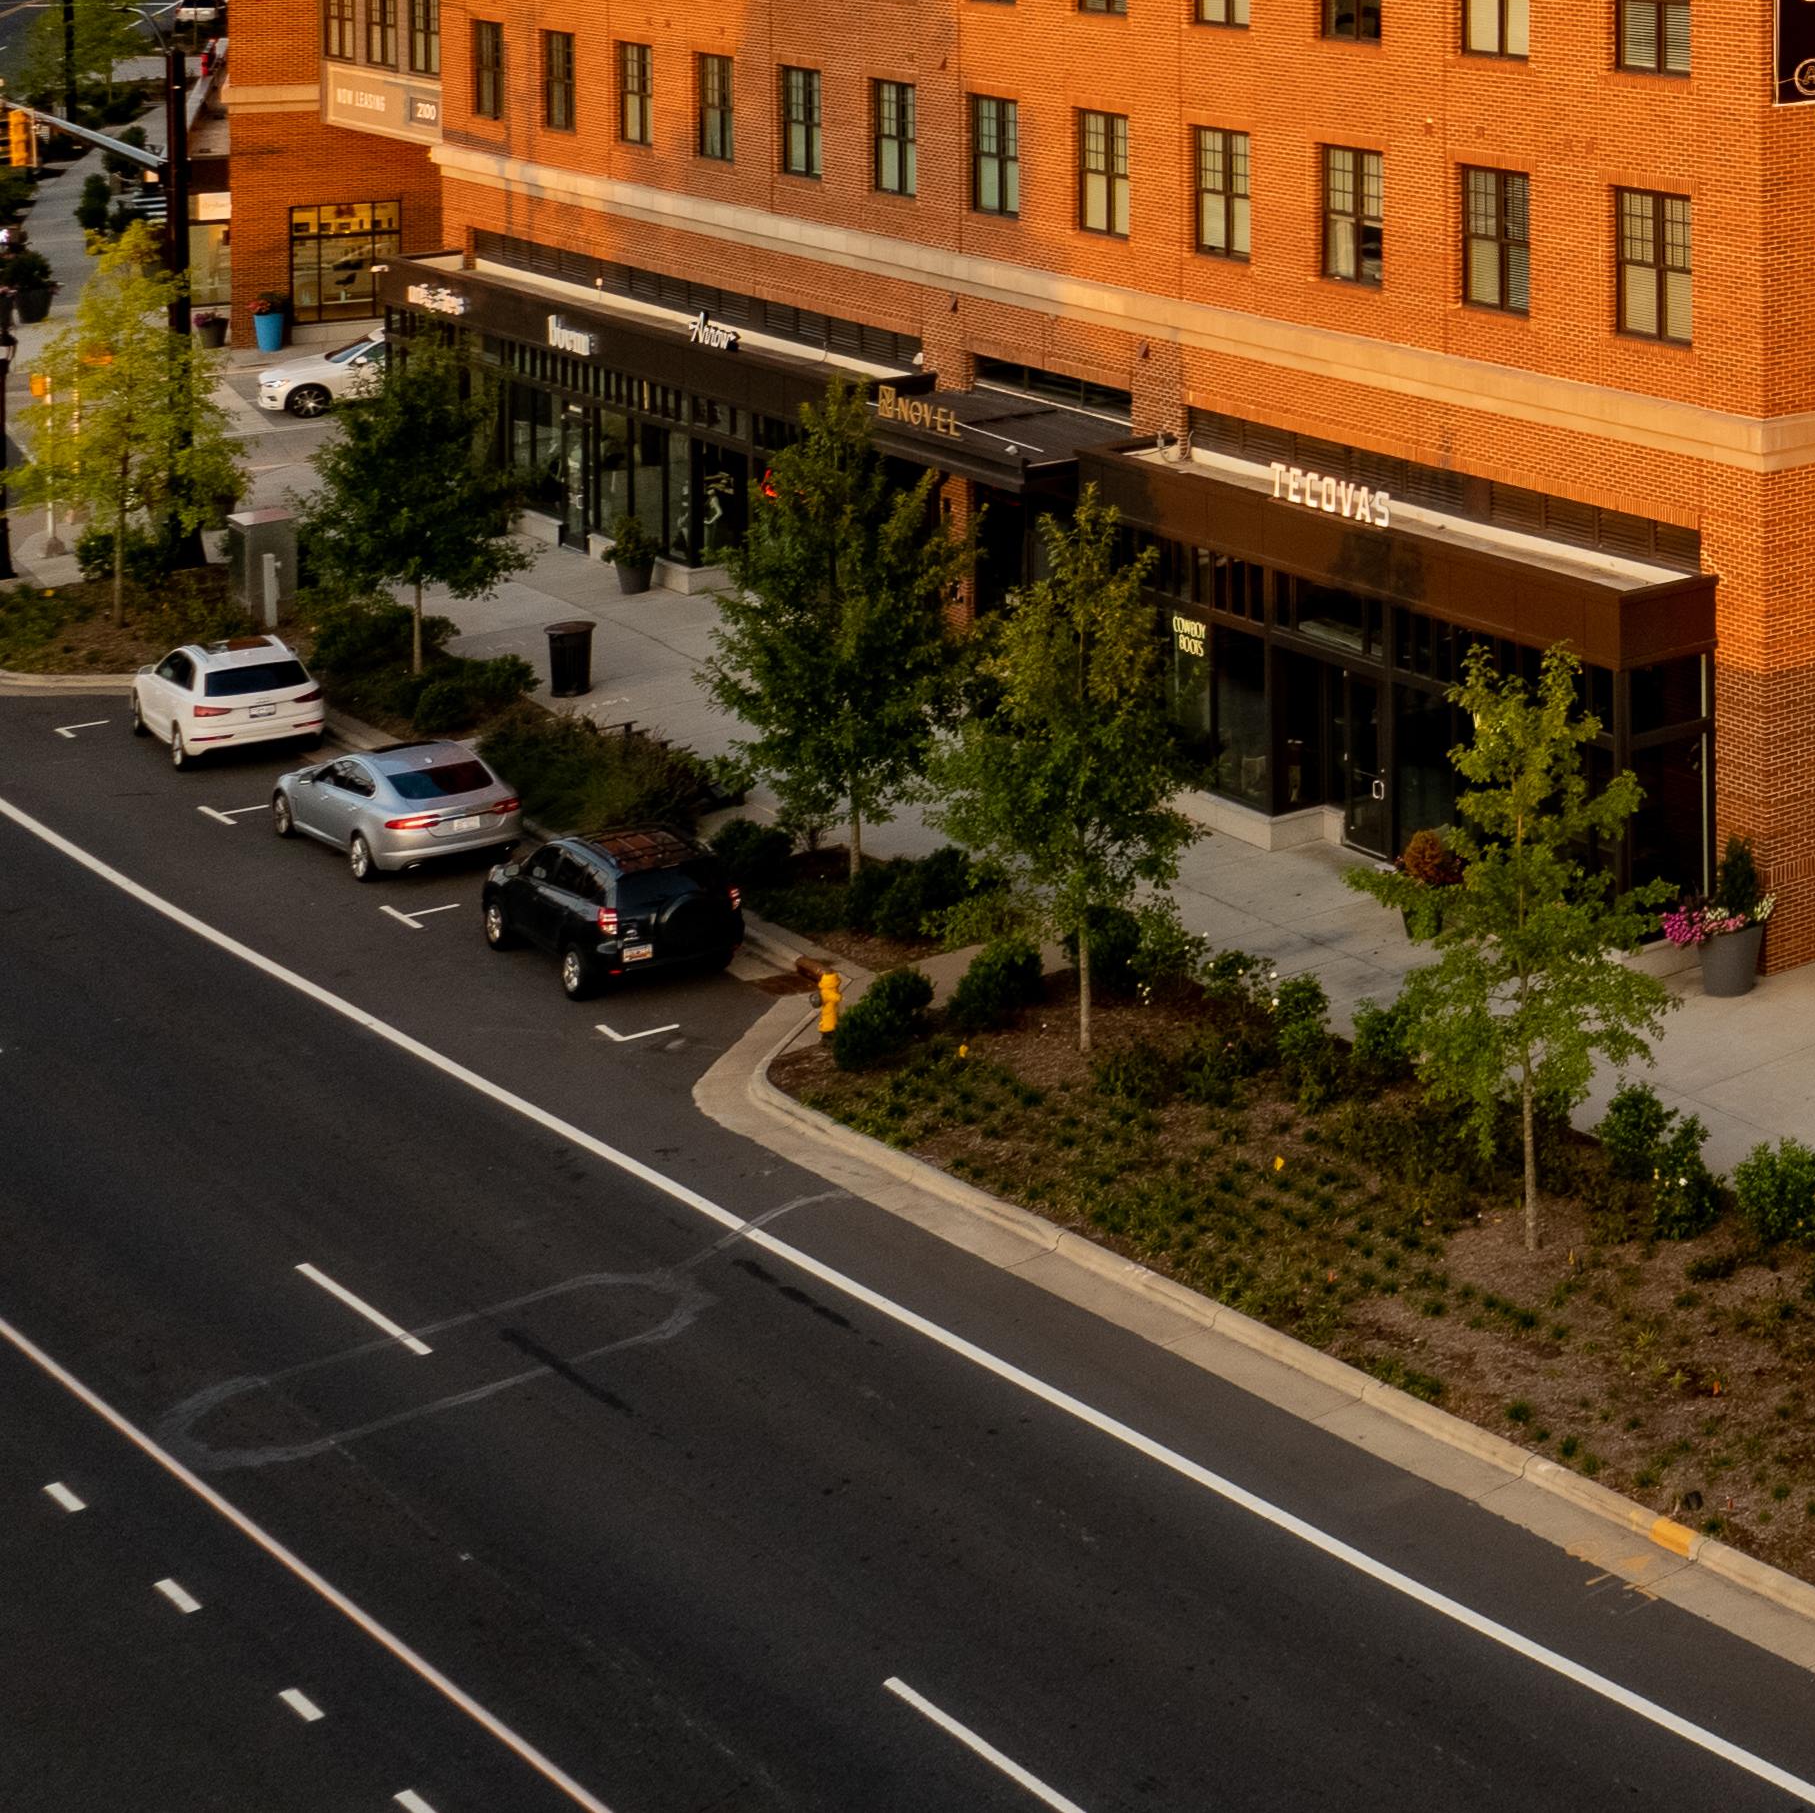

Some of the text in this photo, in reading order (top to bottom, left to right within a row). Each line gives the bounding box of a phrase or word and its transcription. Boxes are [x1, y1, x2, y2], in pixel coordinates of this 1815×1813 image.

[688, 311, 737, 350] Arrow
[897, 397, 961, 437] NOVEL
[1270, 461, 1390, 528] TECOVAS
[1172, 616, 1206, 639] COWBOY
[1179, 633, 1205, 657] BOOTS
